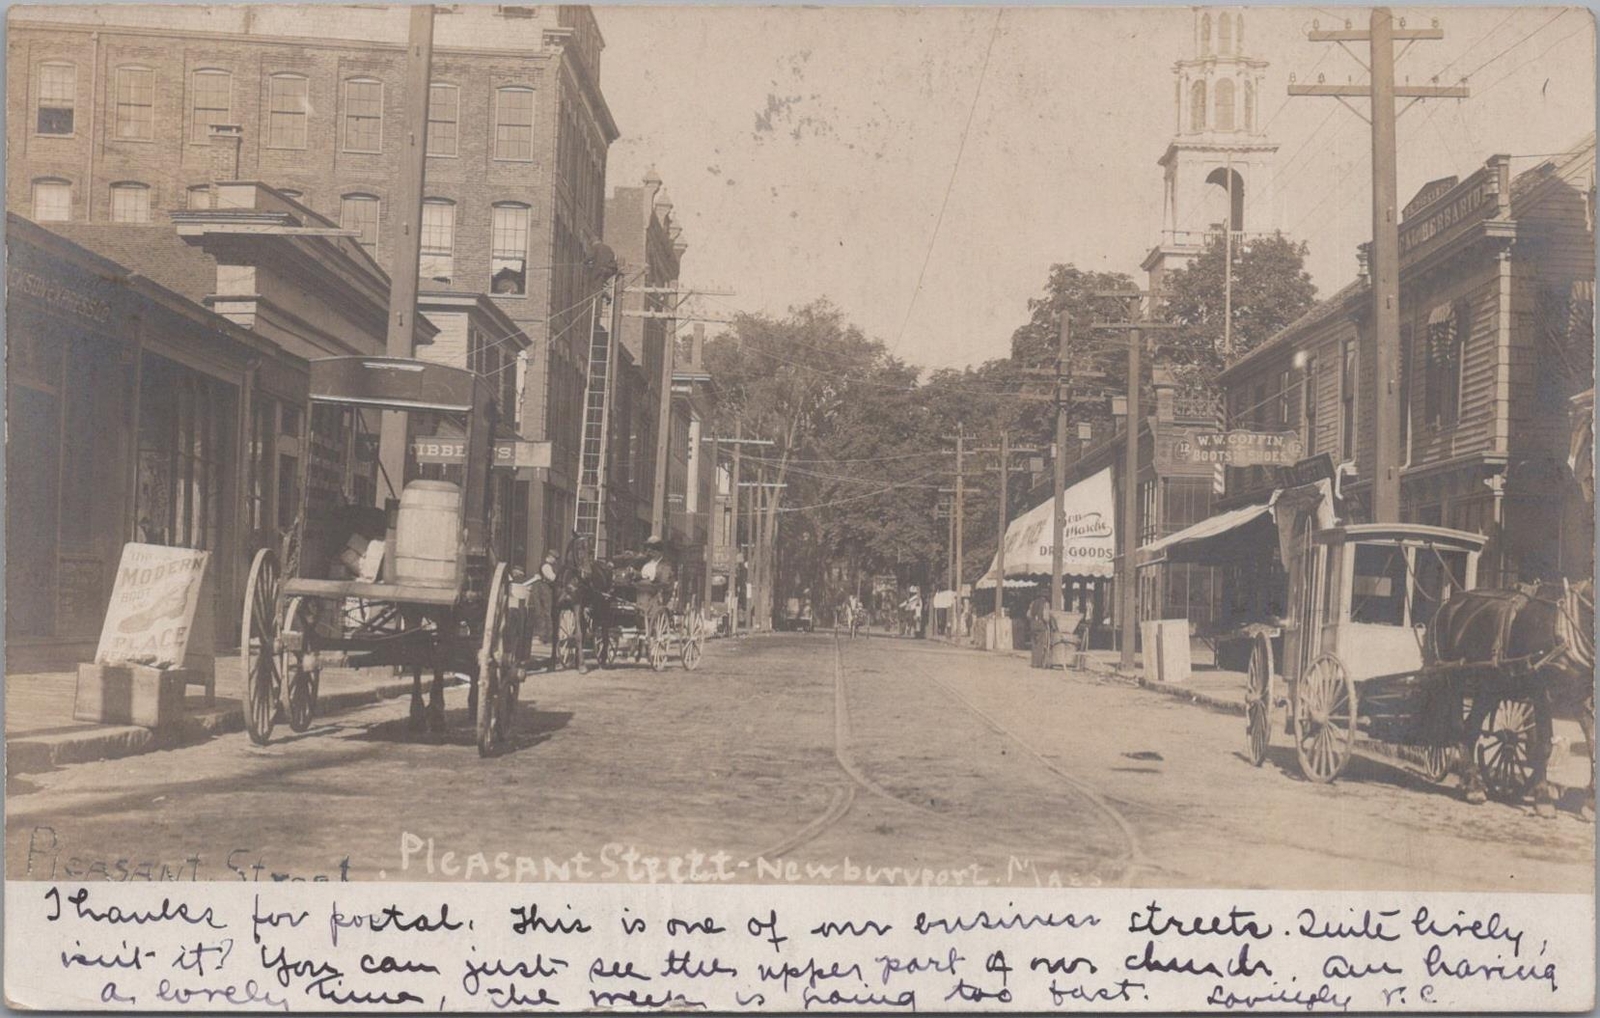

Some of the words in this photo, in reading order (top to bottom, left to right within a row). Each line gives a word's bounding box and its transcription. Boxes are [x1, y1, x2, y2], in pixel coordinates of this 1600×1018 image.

[1069, 547, 1113, 559] GOODS
[120, 556, 205, 586] MODERN
[112, 626, 188, 651] PLACE
[44, 887, 228, 929] Thanks
[251, 893, 310, 944] for
[510, 903, 592, 935] This
[621, 907, 647, 935] is
[666, 917, 726, 935] one
[747, 910, 788, 953] of
[914, 902, 1102, 936] business
[1297, 907, 1401, 941] Quite
[172, 938, 234, 976] it?
[261, 944, 345, 986] You
[360, 954, 441, 975] can
[463, 945, 569, 996] just
[589, 957, 651, 983] see
[660, 950, 738, 977] the
[758, 957, 864, 993] upper
[875, 946, 966, 985] part
[1423, 944, 1558, 992] having
[156, 979, 290, 1011] lovely
[487, 983, 560, 1008] the
[737, 991, 765, 1007] is
[803, 983, 916, 1011] going
[944, 978, 1013, 1003] too
